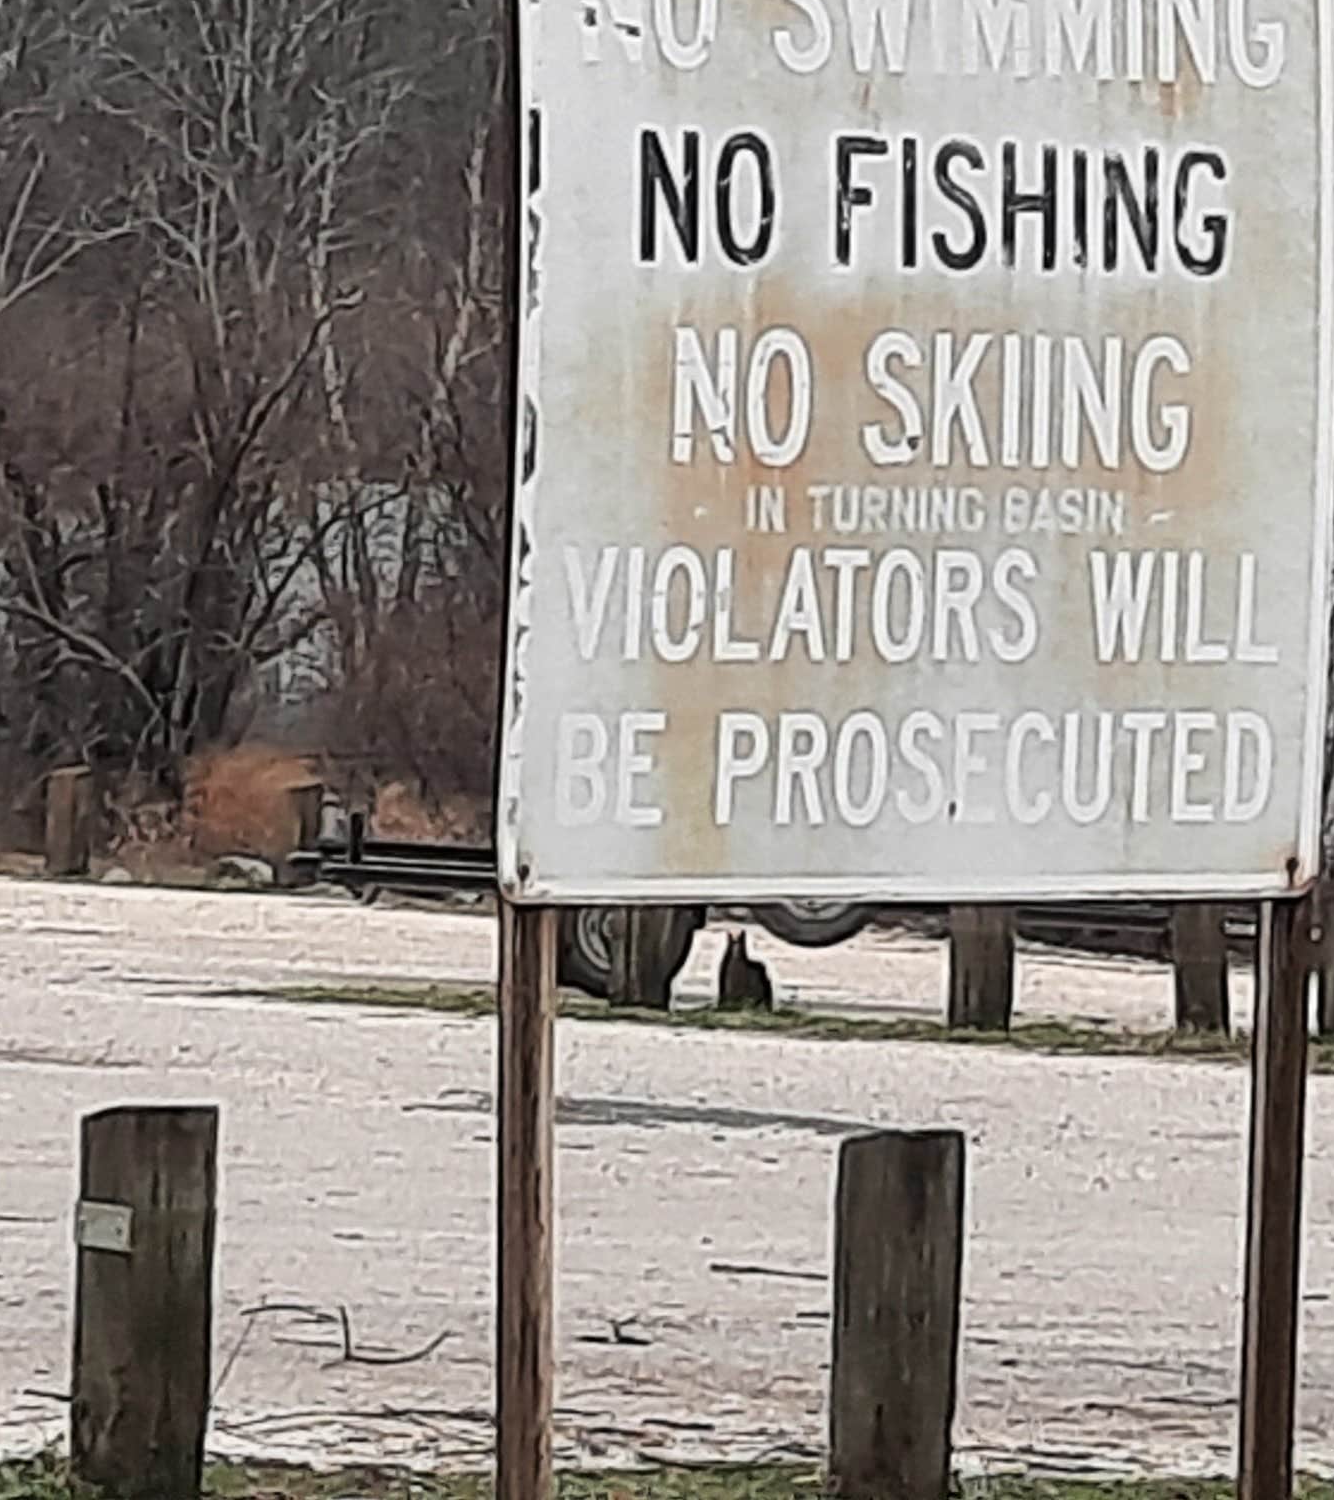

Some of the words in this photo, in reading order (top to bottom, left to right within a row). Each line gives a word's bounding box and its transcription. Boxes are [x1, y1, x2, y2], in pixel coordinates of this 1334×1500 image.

[636, 128, 776, 268] NO
[830, 134, 1230, 278] FISHING
[671, 324, 814, 467] NO
[865, 328, 1192, 474] SKIING
[746, 484, 786, 534] IN
[806, 484, 987, 534] TURNING
[1003, 486, 1125, 536] BASIN
[561, 543, 1041, 664] VIOLATORS
[1090, 548, 1281, 664] WILL
[555, 710, 667, 828] BE
[712, 709, 1274, 828] PROSECUTED
